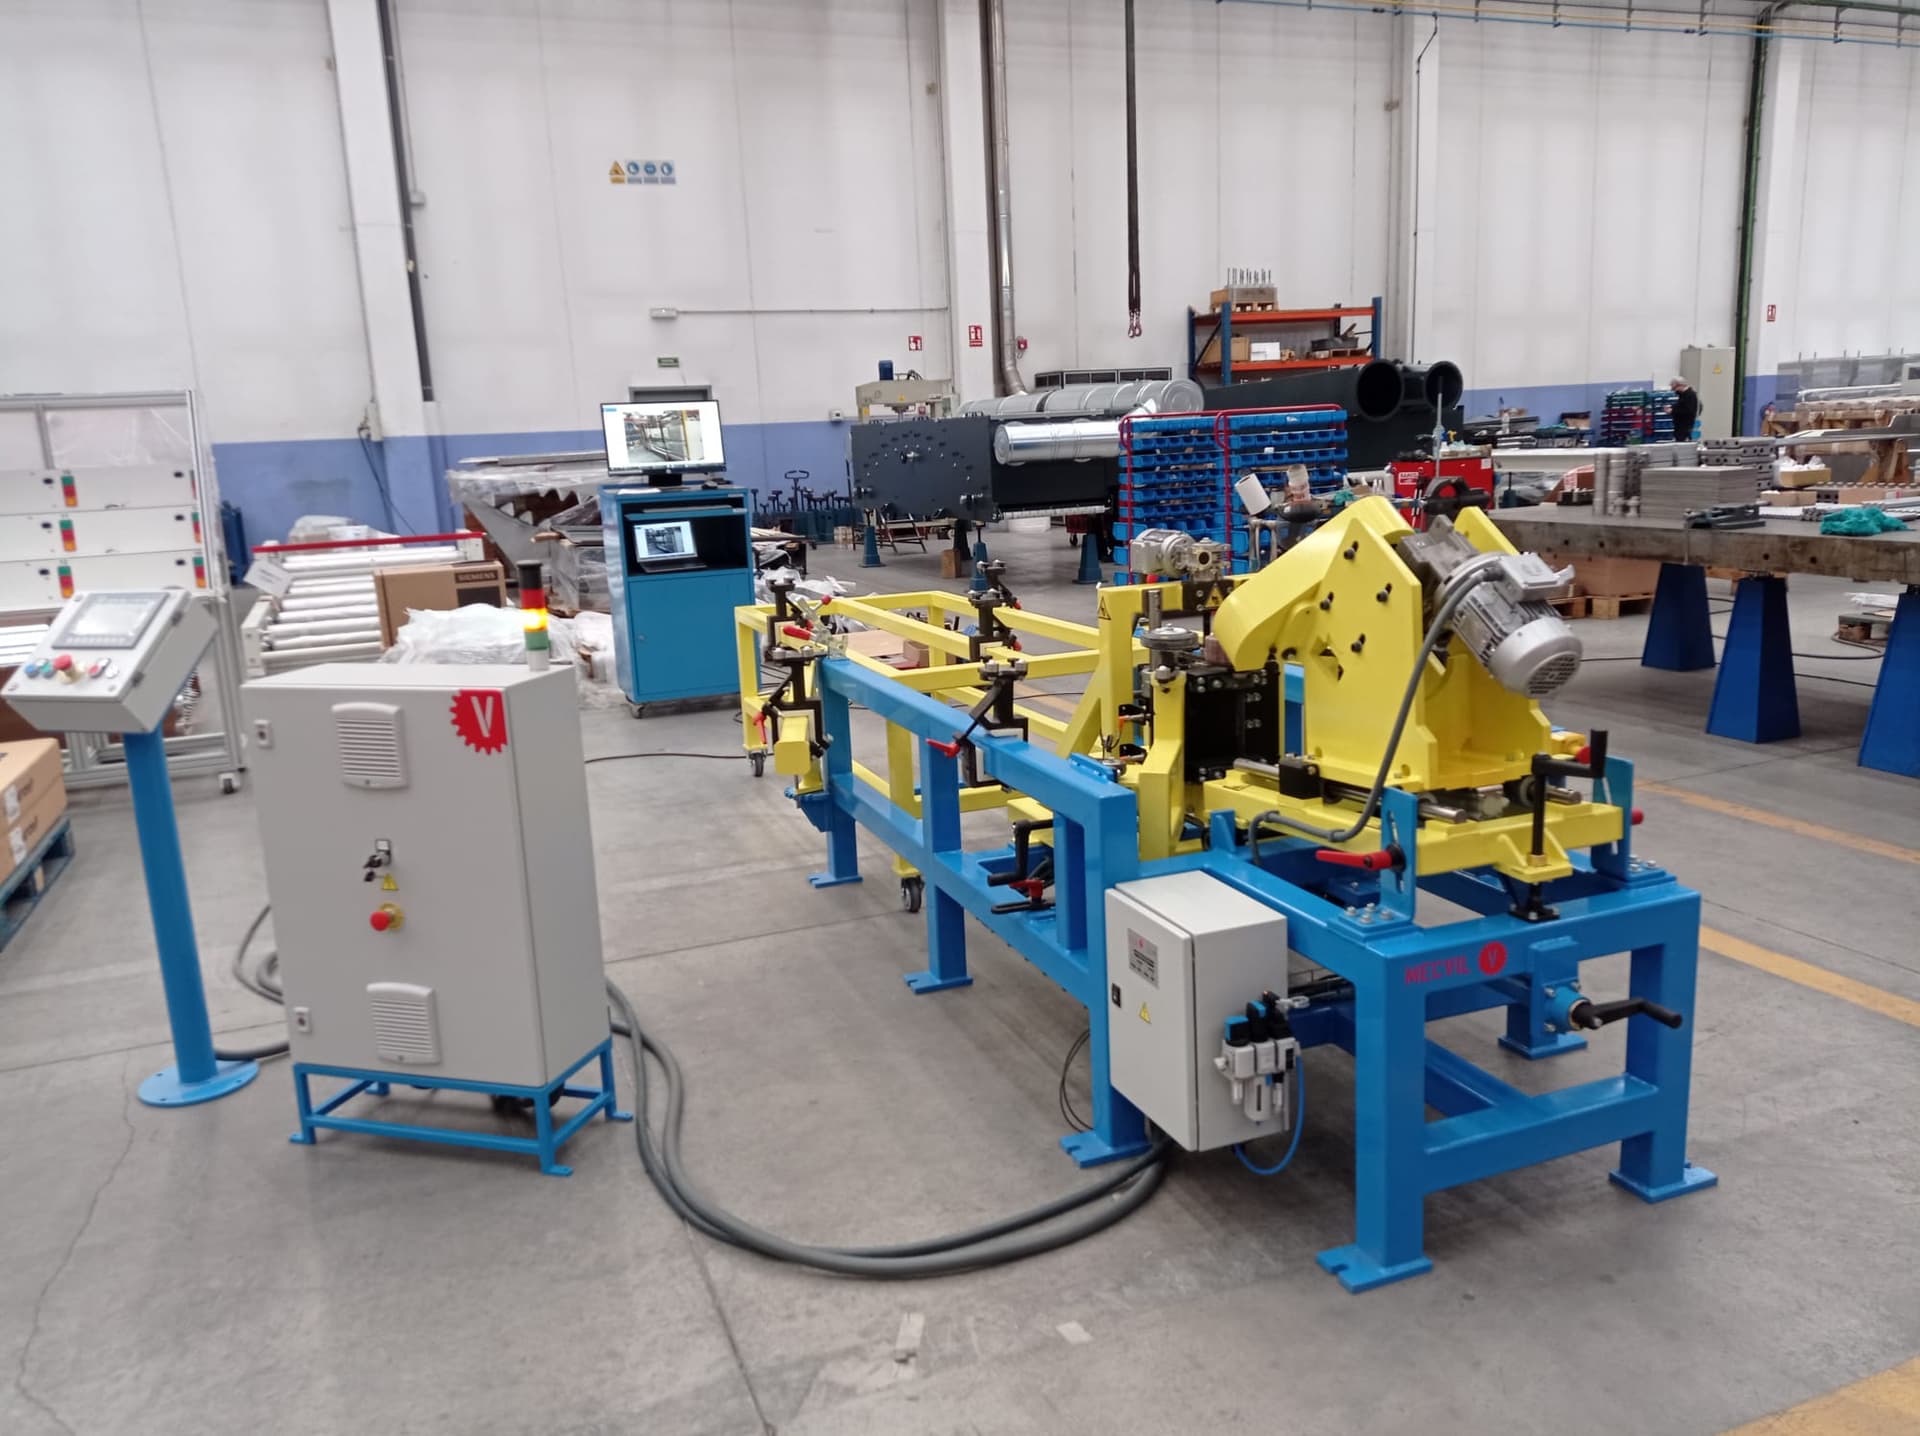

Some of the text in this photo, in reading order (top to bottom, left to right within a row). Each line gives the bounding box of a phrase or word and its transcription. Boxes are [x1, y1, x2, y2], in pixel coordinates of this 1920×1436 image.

[457, 571, 496, 582] SIEMENS
[471, 696, 494, 737] V
[1404, 955, 1471, 984] MECVIL
